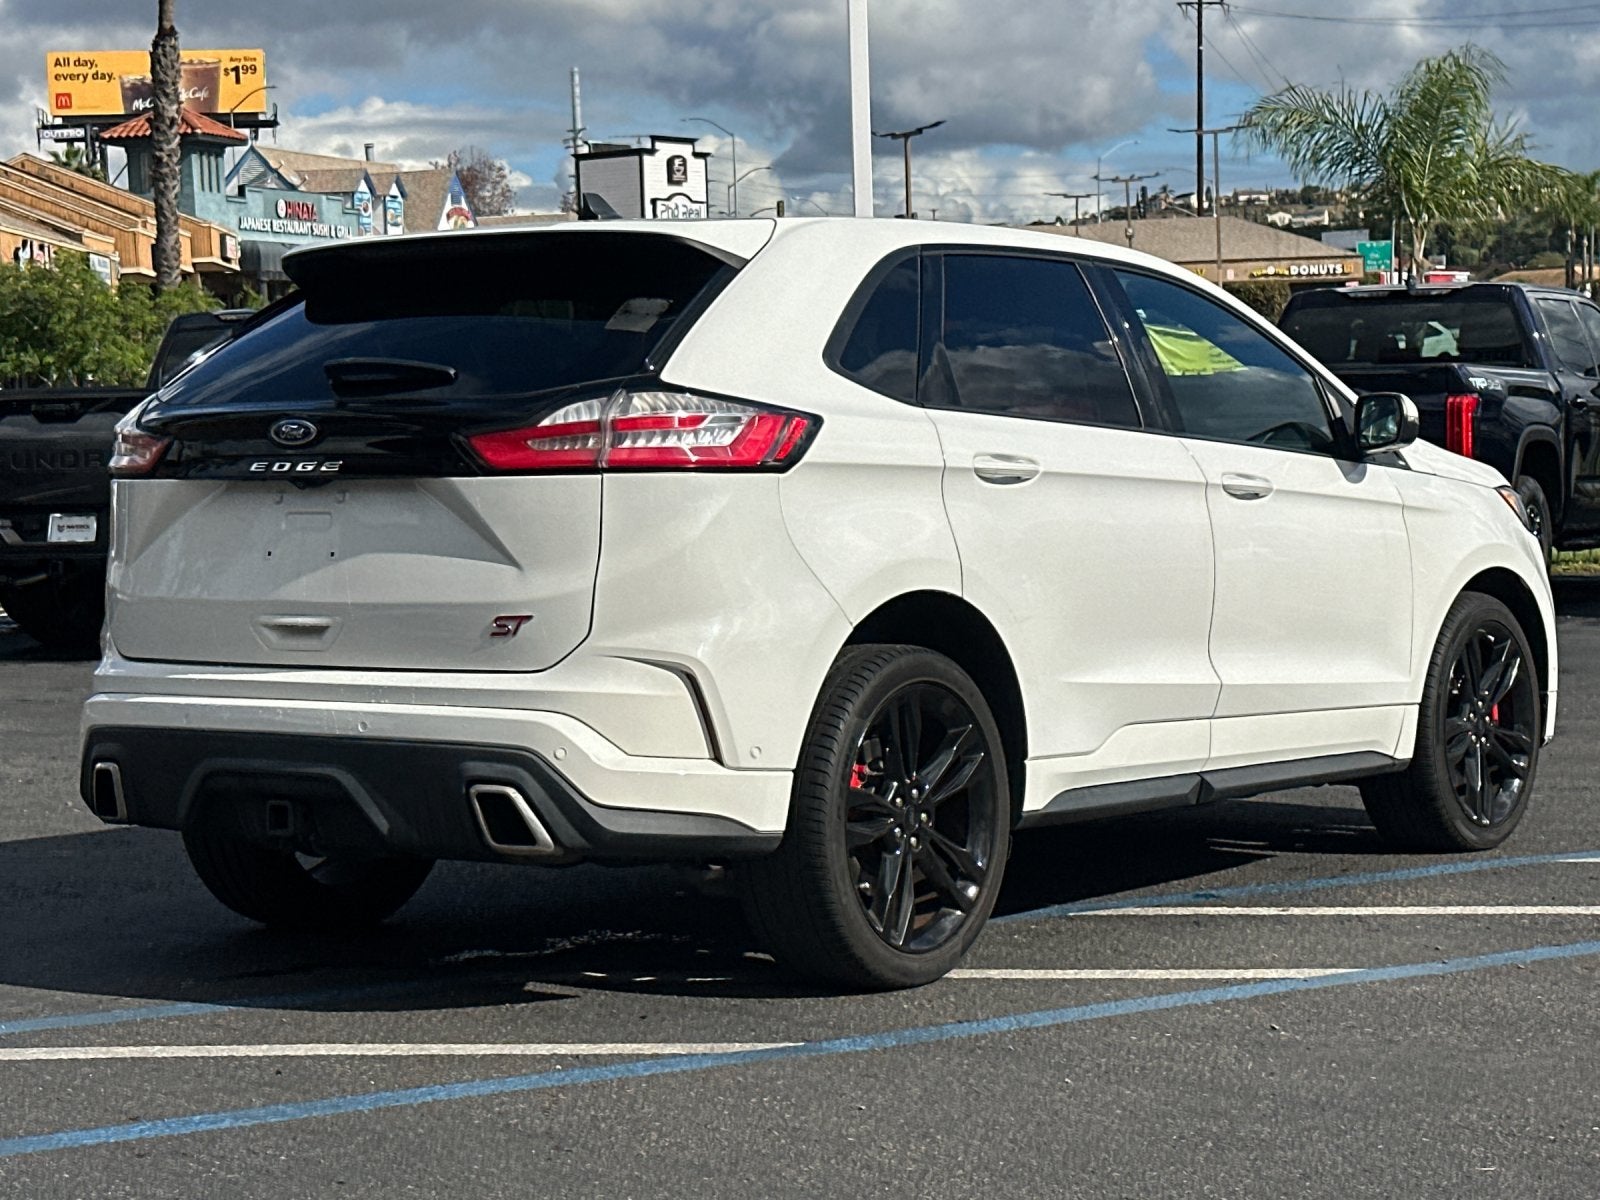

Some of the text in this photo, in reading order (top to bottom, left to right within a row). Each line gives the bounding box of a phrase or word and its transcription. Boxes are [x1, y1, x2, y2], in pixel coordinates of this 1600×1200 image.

[54, 57, 98, 70] All day,
[54, 71, 116, 83] every day.
[132, 98, 154, 111] McC
[42, 129, 84, 138] OUTFRO
[240, 217, 271, 231] JAPANESE
[272, 220, 311, 235] RESTAURANT
[312, 223, 330, 237] SUSHI
[1290, 263, 1343, 275] DONUTS
[1, 449, 104, 472] UNDR
[249, 461, 343, 472] EDGE
[490, 614, 534, 638] ST
